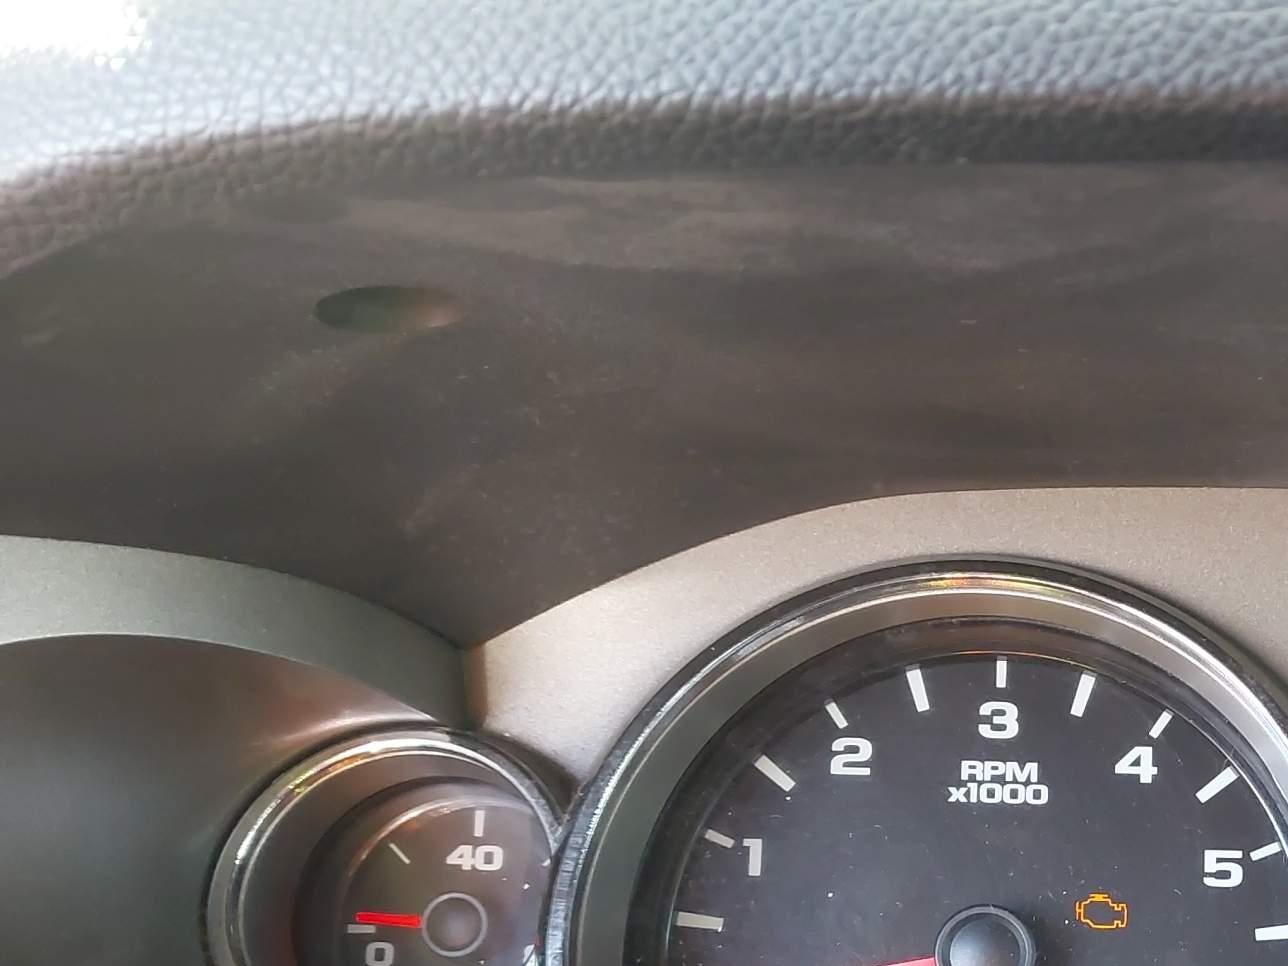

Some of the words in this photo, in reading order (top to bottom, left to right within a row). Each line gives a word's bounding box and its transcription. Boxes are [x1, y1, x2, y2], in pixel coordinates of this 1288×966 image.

[977, 701, 1019, 739] 3
[829, 737, 872, 776] 2
[959, 760, 1038, 783] RPM
[1114, 746, 1158, 784] 4
[947, 783, 1049, 806] x1000
[446, 845, 504, 871] 40
[742, 838, 763, 876] 1
[1202, 849, 1244, 888] 5
